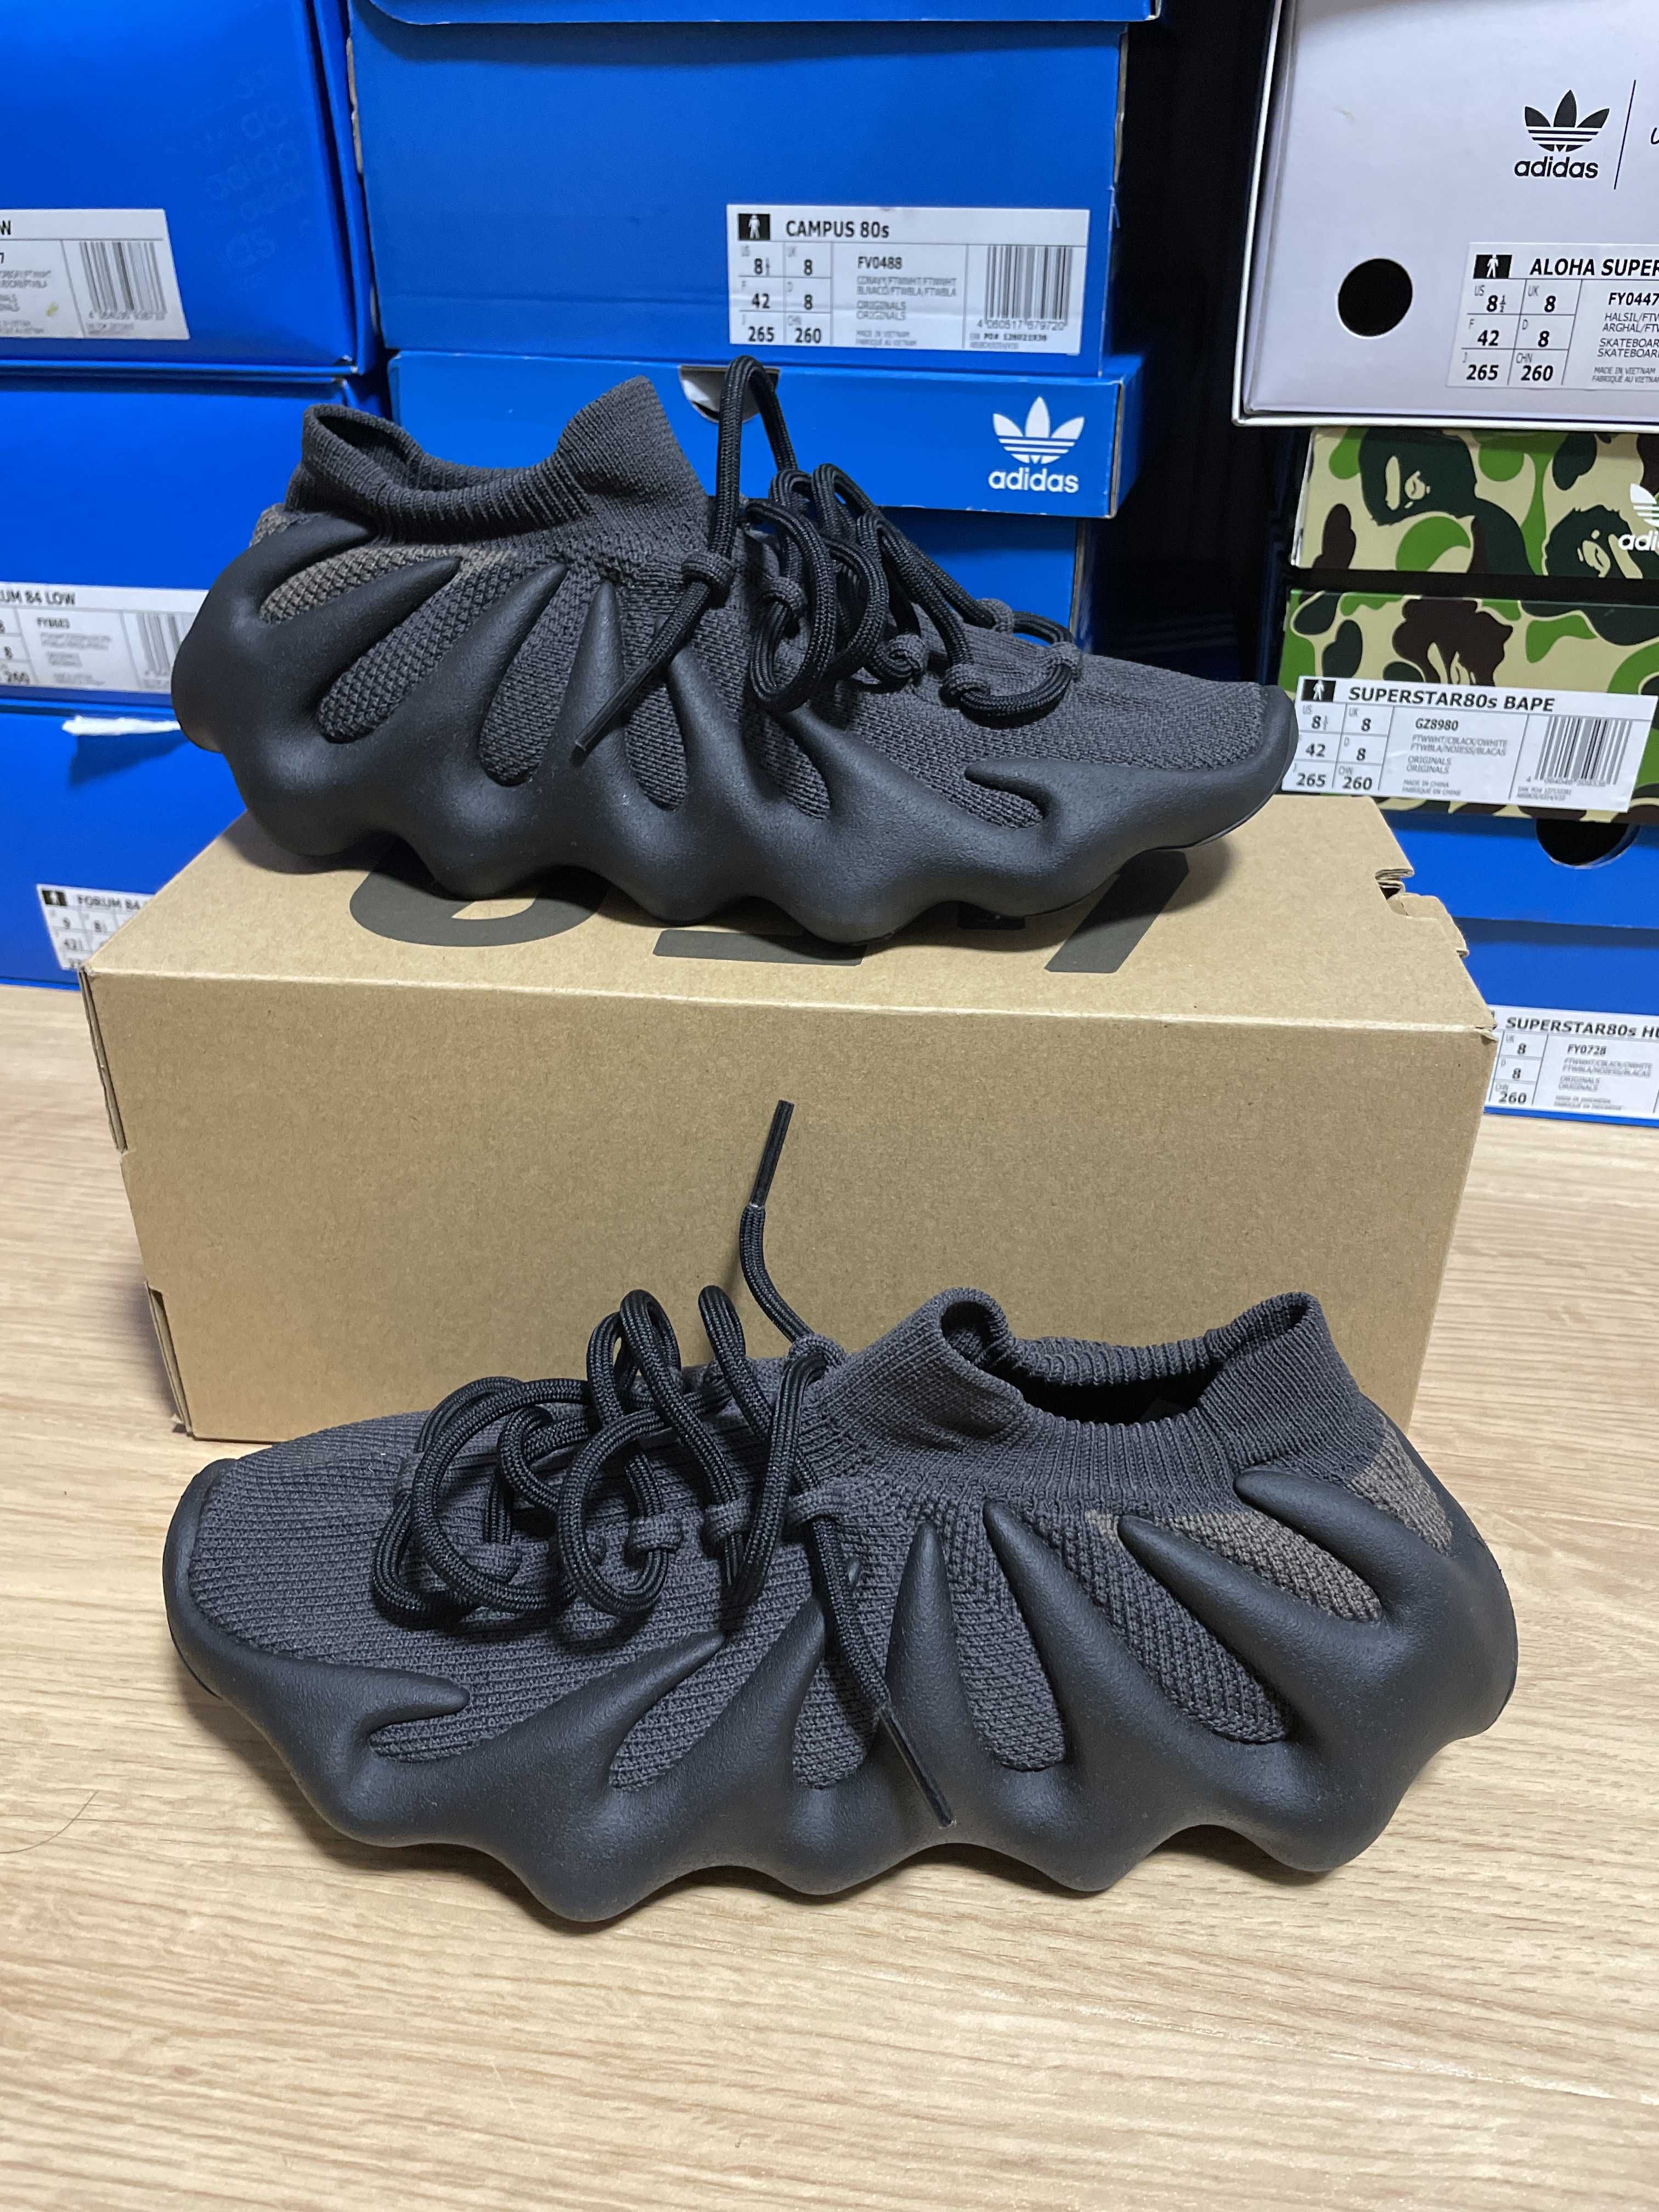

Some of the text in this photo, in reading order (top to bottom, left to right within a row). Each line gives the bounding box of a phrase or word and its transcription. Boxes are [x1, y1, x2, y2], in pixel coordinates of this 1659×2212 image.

[1514, 156, 1598, 178] adidas
[786, 220, 889, 238] CAMPUS 80s
[804, 259, 812, 276] 8
[857, 256, 902, 269] FV0488
[1530, 258, 1595, 275] ALOHA
[1475, 285, 1485, 296] US
[1528, 285, 1539, 296] UK
[751, 294, 770, 309] 42
[804, 294, 812, 310] 8
[1544, 295, 1556, 313] 8
[1608, 292, 1659, 306] FY0447
[1522, 319, 1528, 330] D
[749, 326, 774, 342] 265
[795, 328, 821, 344] 260
[1477, 330, 1499, 346] 42
[1538, 330, 1550, 347] 8
[1516, 353, 1533, 364] CHN
[1466, 364, 1499, 381] 265
[1521, 365, 1553, 381] 260
[988, 467, 1079, 493] adidas
[1618, 530, 1659, 551] adi
[1348, 686, 1555, 712] SUPERSTAR80s BAPE
[1348, 707, 1359, 717] UK
[1361, 717, 1372, 732] 8
[1415, 718, 1458, 731] GZ8980
[1305, 743, 1325, 757] 42
[1356, 747, 1366, 761] 8
[1408, 755, 1452, 765] ORIGINALS
[1406, 764, 1449, 774] ORIGINALS
[1296, 772, 1326, 787] 265
[1342, 776, 1372, 790] 260
[1505, 1017, 1637, 1037] SUPERSTAR80s
[1517, 1042, 1527, 1055] 8
[1567, 1043, 1607, 1056] FY0728
[1511, 1068, 1521, 1080] 8
[1498, 1092, 1527, 1104] 260
